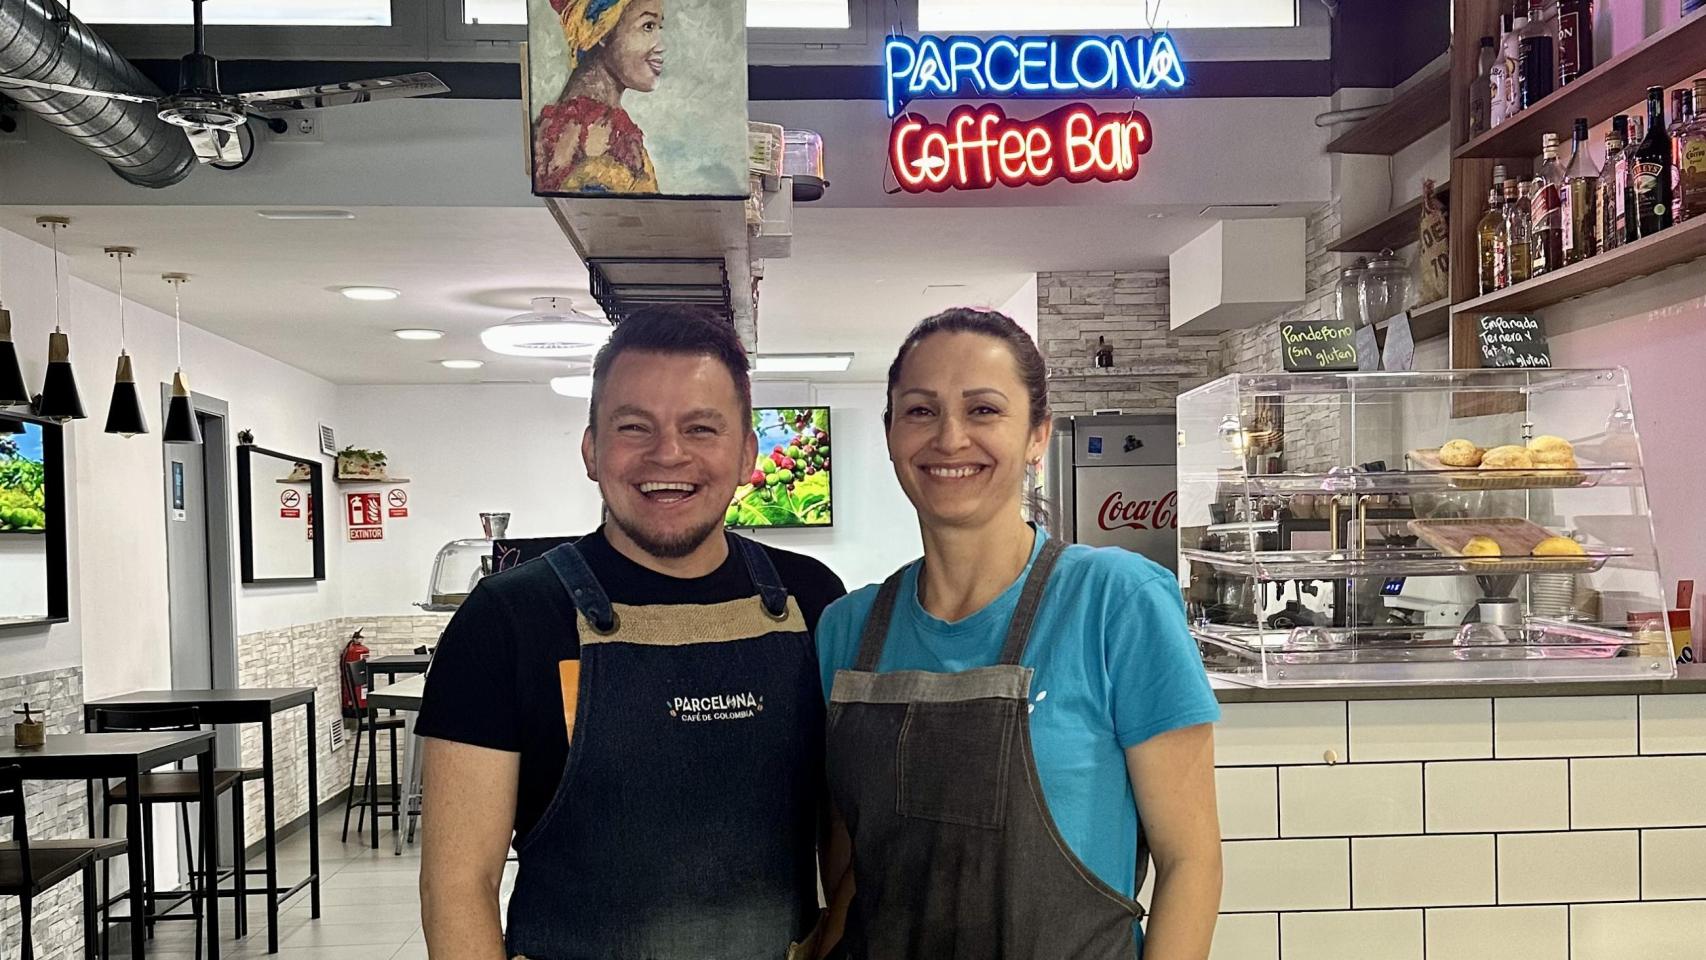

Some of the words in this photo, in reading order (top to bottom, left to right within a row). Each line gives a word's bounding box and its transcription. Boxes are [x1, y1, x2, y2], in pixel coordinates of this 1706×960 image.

[886, 36, 1185, 117] PARCELONA
[896, 114, 1053, 184] Coffee
[1065, 112, 1145, 174] Bar
[1479, 330, 1523, 345] Ternera
[1316, 343, 1357, 367] gluten)
[1482, 344, 1515, 359] Patta
[1516, 353, 1551, 367] gluten)
[351, 529, 382, 539] EXTINTOR
[674, 691, 757, 712] PARCELONA
[681, 712, 701, 722] CAFÉ
[702, 713, 712, 721] DE
[713, 710, 754, 720] COLOMBIA
